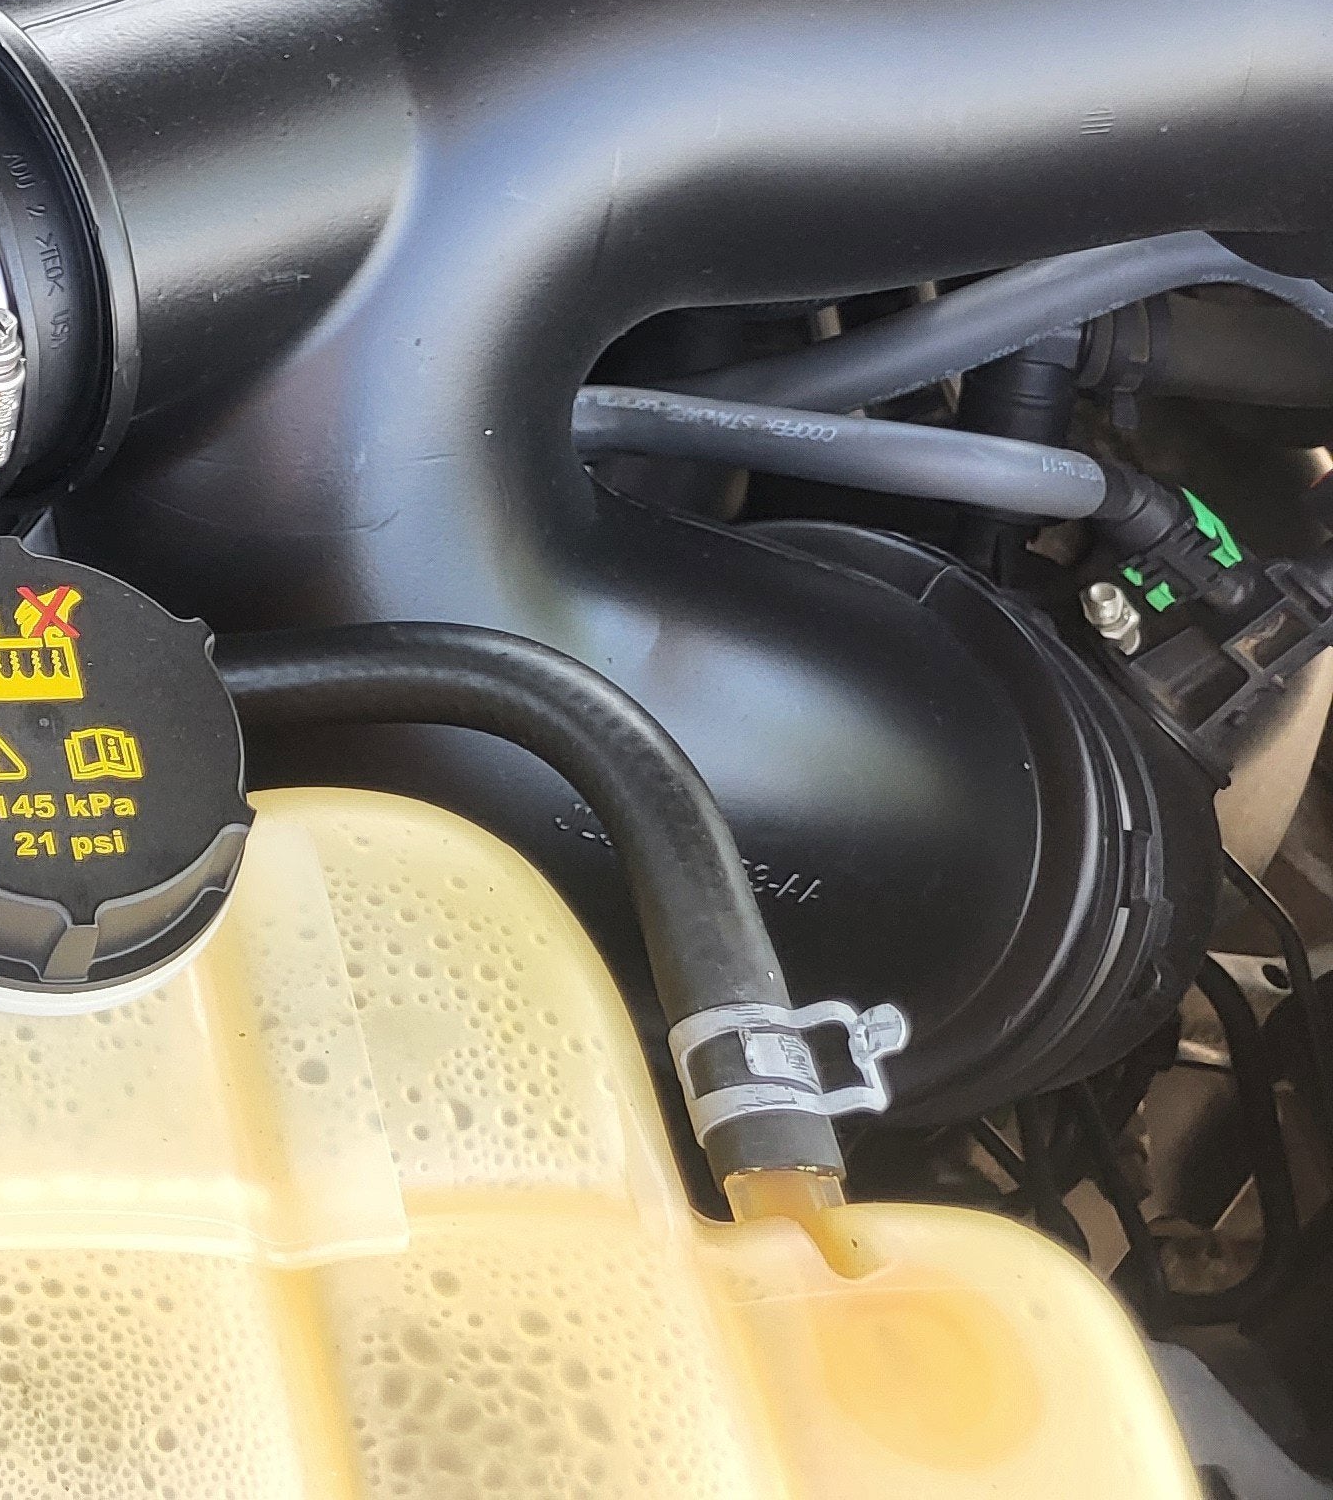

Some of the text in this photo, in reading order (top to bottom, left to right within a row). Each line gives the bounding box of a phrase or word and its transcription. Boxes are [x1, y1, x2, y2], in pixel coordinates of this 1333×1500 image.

[65, 793, 137, 819] kPa
[14, 831, 126, 861] 21 psi
